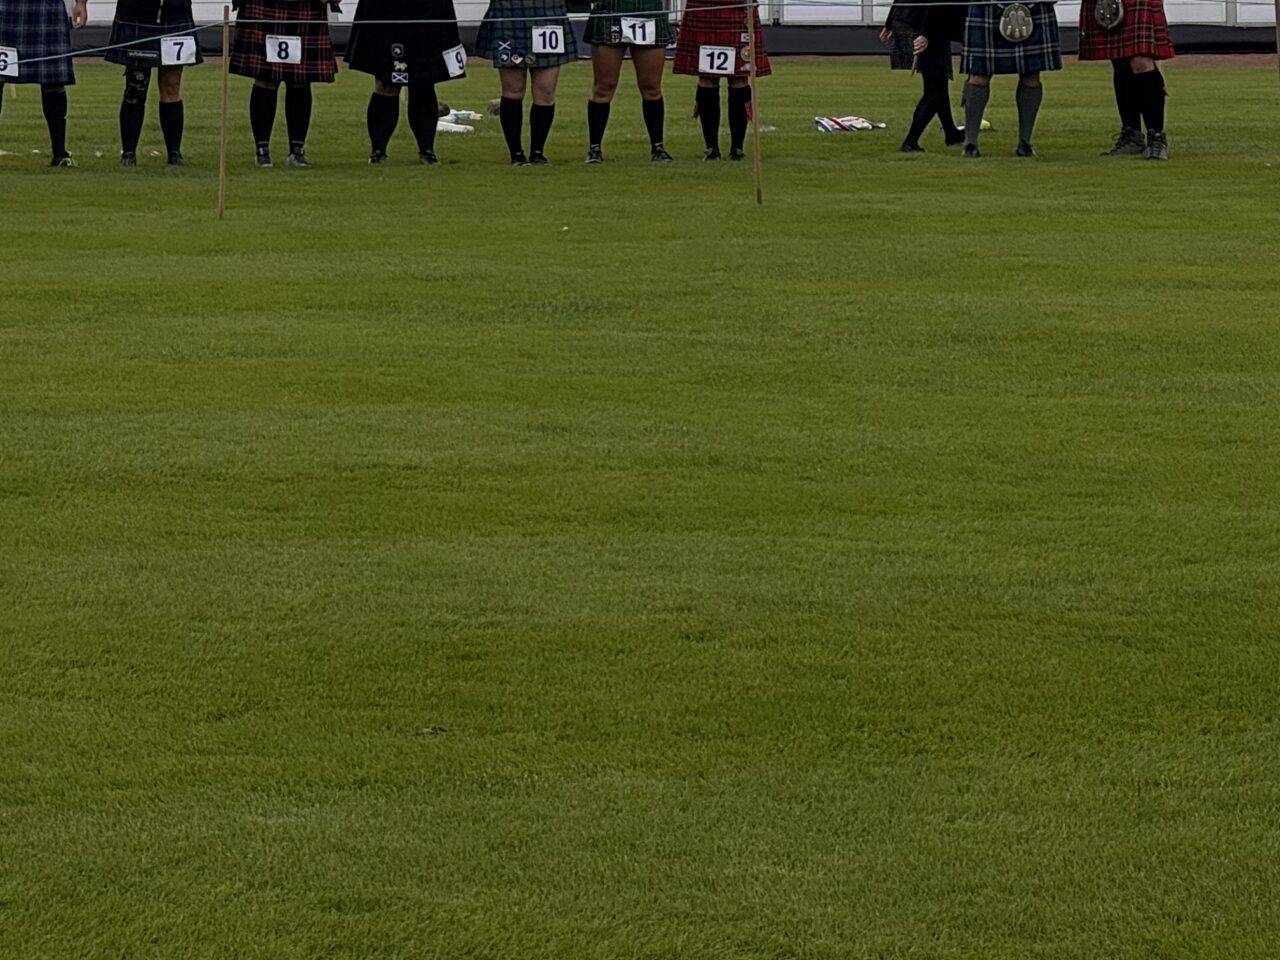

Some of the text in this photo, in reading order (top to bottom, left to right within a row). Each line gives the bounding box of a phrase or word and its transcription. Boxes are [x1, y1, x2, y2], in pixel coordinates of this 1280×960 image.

[538, 30, 559, 50] 10
[628, 23, 647, 42] 11
[172, 41, 184, 61] 7
[277, 41, 289, 60] 8
[455, 51, 465, 70] 9
[706, 51, 729, 71] 12
